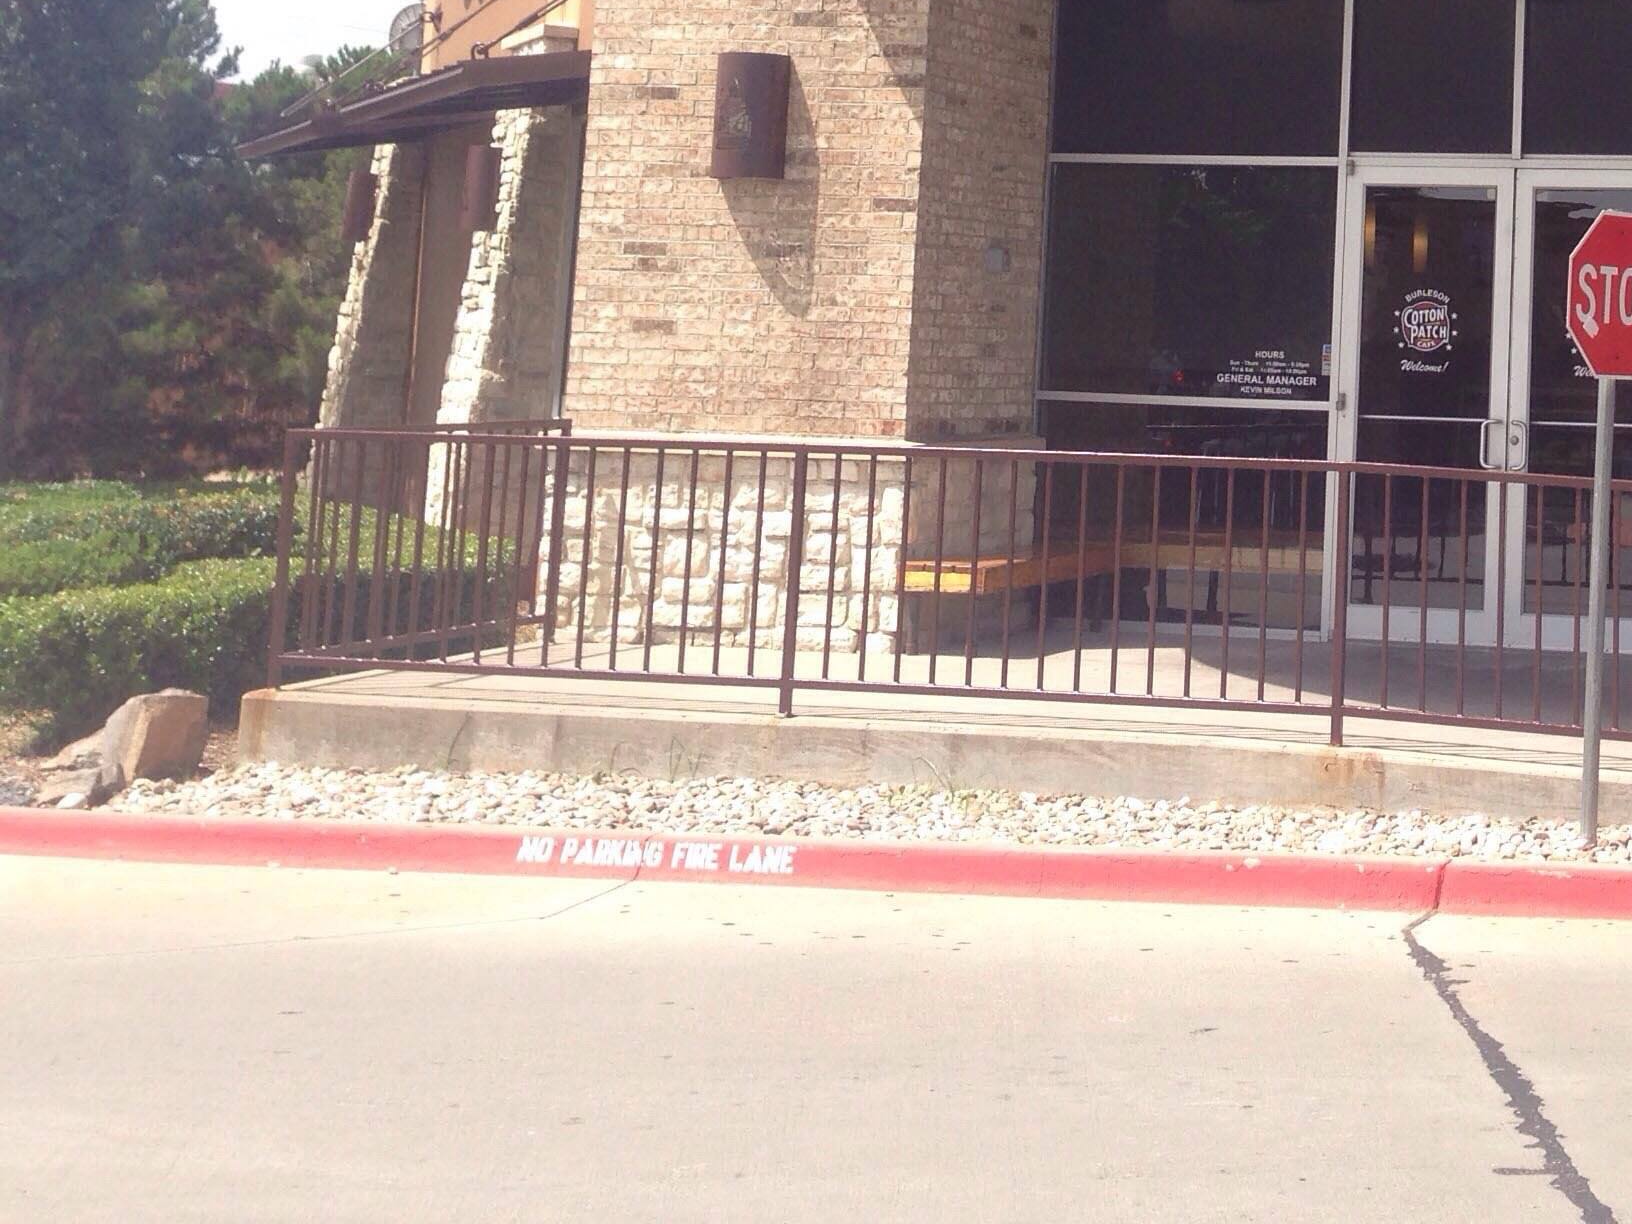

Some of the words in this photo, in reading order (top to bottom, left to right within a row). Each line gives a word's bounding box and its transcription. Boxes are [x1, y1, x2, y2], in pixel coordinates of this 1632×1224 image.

[1405, 289, 1450, 303] BURLESON
[1404, 309, 1444, 327] COTTON
[1411, 325, 1446, 344] PATCH
[1400, 359, 1449, 372] Welcome!
[1217, 373, 1264, 384] GENERAL
[1266, 376, 1317, 385] MANAGER
[516, 836, 555, 863] NO
[560, 838, 664, 868] PARKING
[671, 842, 723, 870] FIRE
[729, 845, 797, 874] LANE
